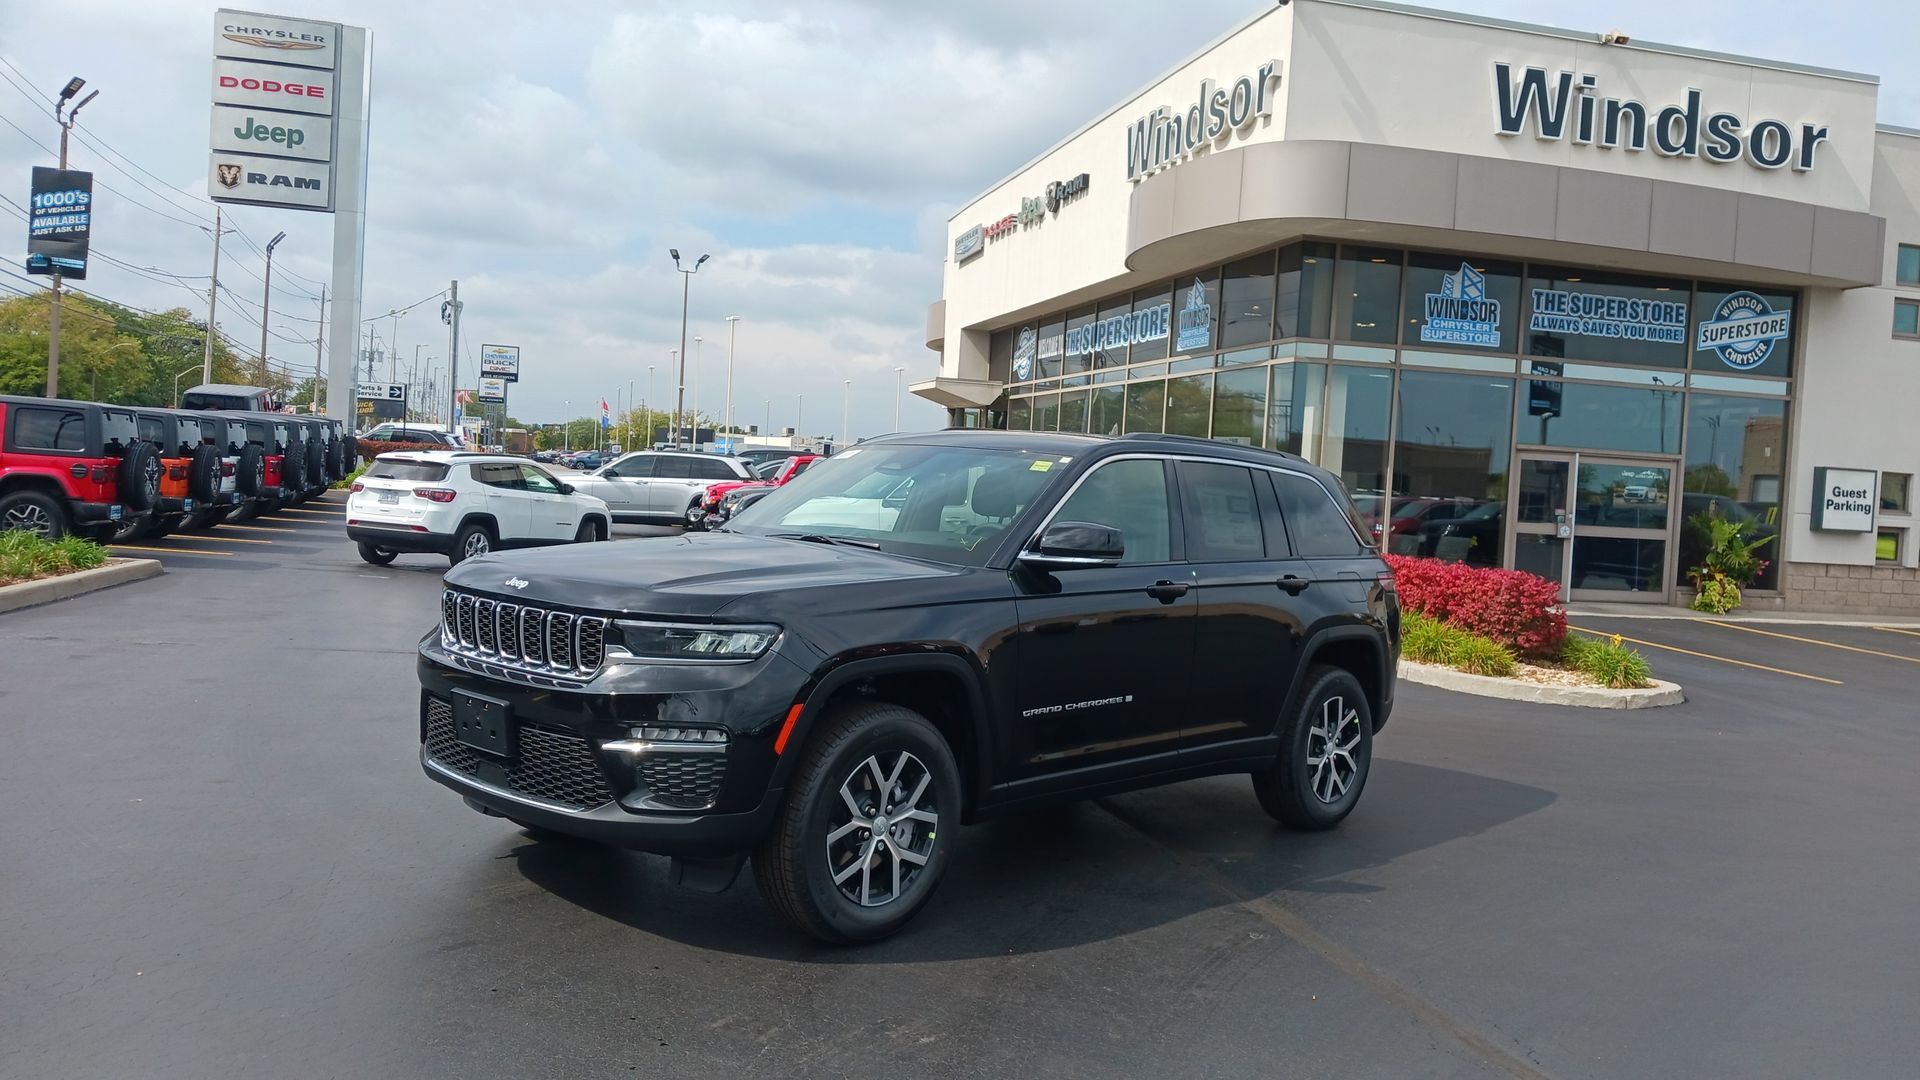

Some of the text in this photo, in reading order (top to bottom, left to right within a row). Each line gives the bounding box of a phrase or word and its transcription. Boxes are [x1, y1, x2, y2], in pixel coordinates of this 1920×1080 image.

[224, 25, 325, 43] CHRYSLER
[219, 76, 325, 98] DODGE
[1126, 60, 1277, 183] Windsor
[1494, 62, 1828, 171] Windsor
[234, 117, 304, 149] Jeep
[247, 172, 321, 190] RAM
[1056, 173, 1090, 200] RAM
[34, 192, 88, 207] 1000's
[48, 206, 86, 214] VEHICLES
[33, 214, 88, 228] AVAILABLE
[1428, 297, 1498, 323] WINDSOR
[1534, 290, 1686, 325] THE SUPERSTORE
[1720, 297, 1763, 318] WINDSOR
[1066, 328, 1081, 355] THE
[1082, 304, 1170, 353] SUPERSTORE
[1424, 329, 1497, 344] SUPERSTORE
[1432, 320, 1490, 332] CHRYSLER
[1532, 316, 1684, 342] ALWAYS SAVES YOU MORE!
[1702, 318, 1787, 343] SUPERSTORE
[1725, 342, 1767, 364] CHRYSLER
[356, 400, 375, 408] UICK
[1832, 486, 1868, 499] Guest
[1825, 498, 1872, 515] Parking
[505, 576, 529, 589] Jeep
[1022, 696, 1123, 717] GRAND CHEROKEE
